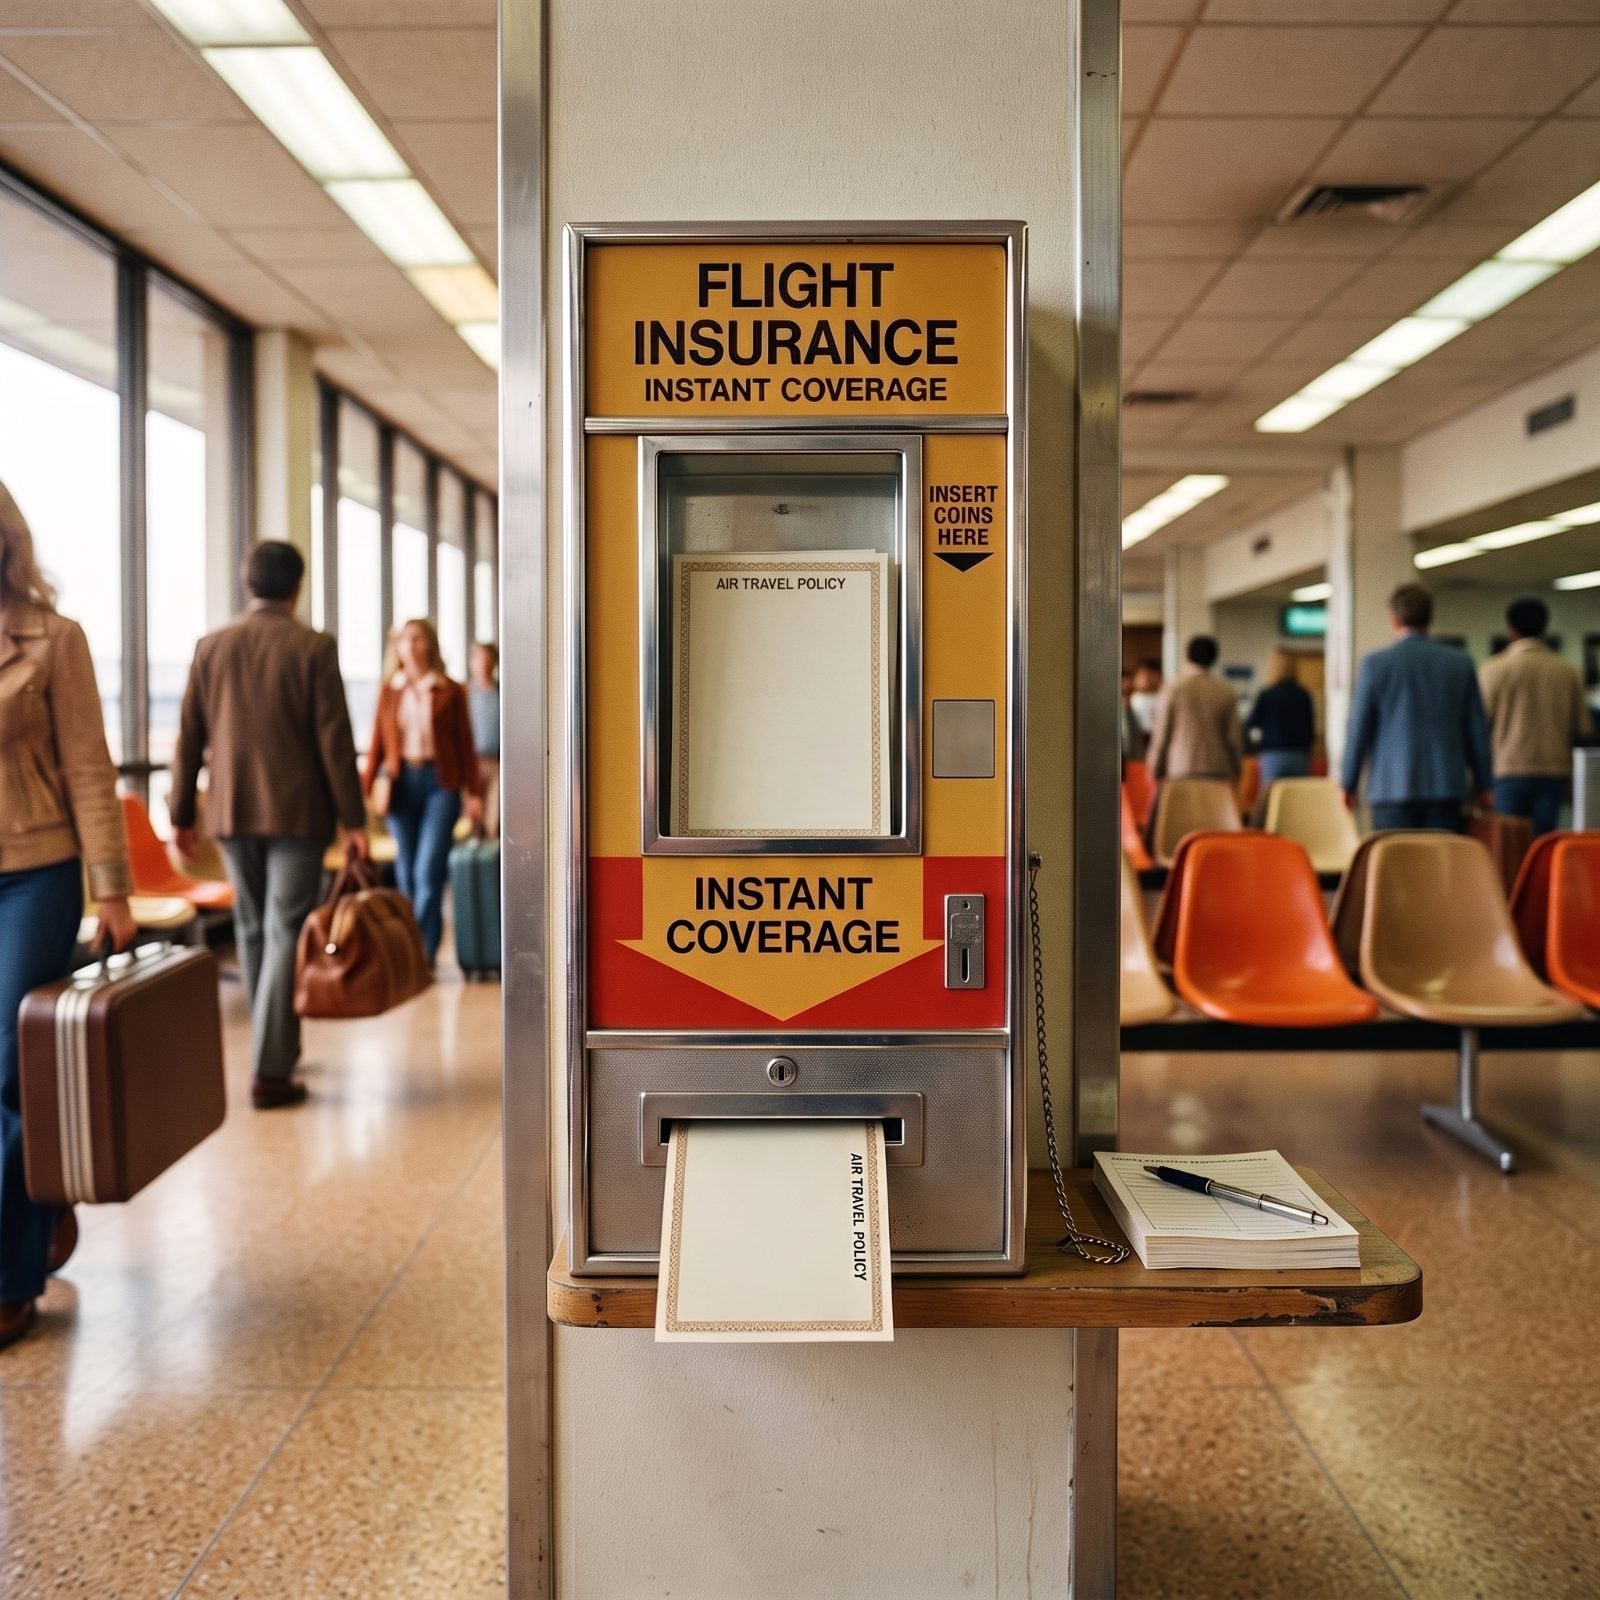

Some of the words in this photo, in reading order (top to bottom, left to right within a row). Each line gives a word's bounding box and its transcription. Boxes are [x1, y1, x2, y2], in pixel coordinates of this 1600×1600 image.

[698, 262, 895, 308] FLIGHT
[635, 319, 958, 366] INSURANCE
[645, 378, 771, 402] INSTANT
[781, 377, 948, 402] COVERAGE
[929, 485, 998, 503] INSERT
[933, 506, 993, 525] COINS
[938, 528, 989, 546] HERE
[716, 577, 739, 590] AIR
[741, 577, 794, 590] TRAVEL
[797, 577, 846, 590] POLICY
[695, 877, 873, 911] INSTANT
[666, 919, 900, 954] COVERAGE
[850, 1152, 863, 1175] AIR
[851, 1178, 865, 1227] TRAVEL
[853, 1231, 867, 1281] POLICY
